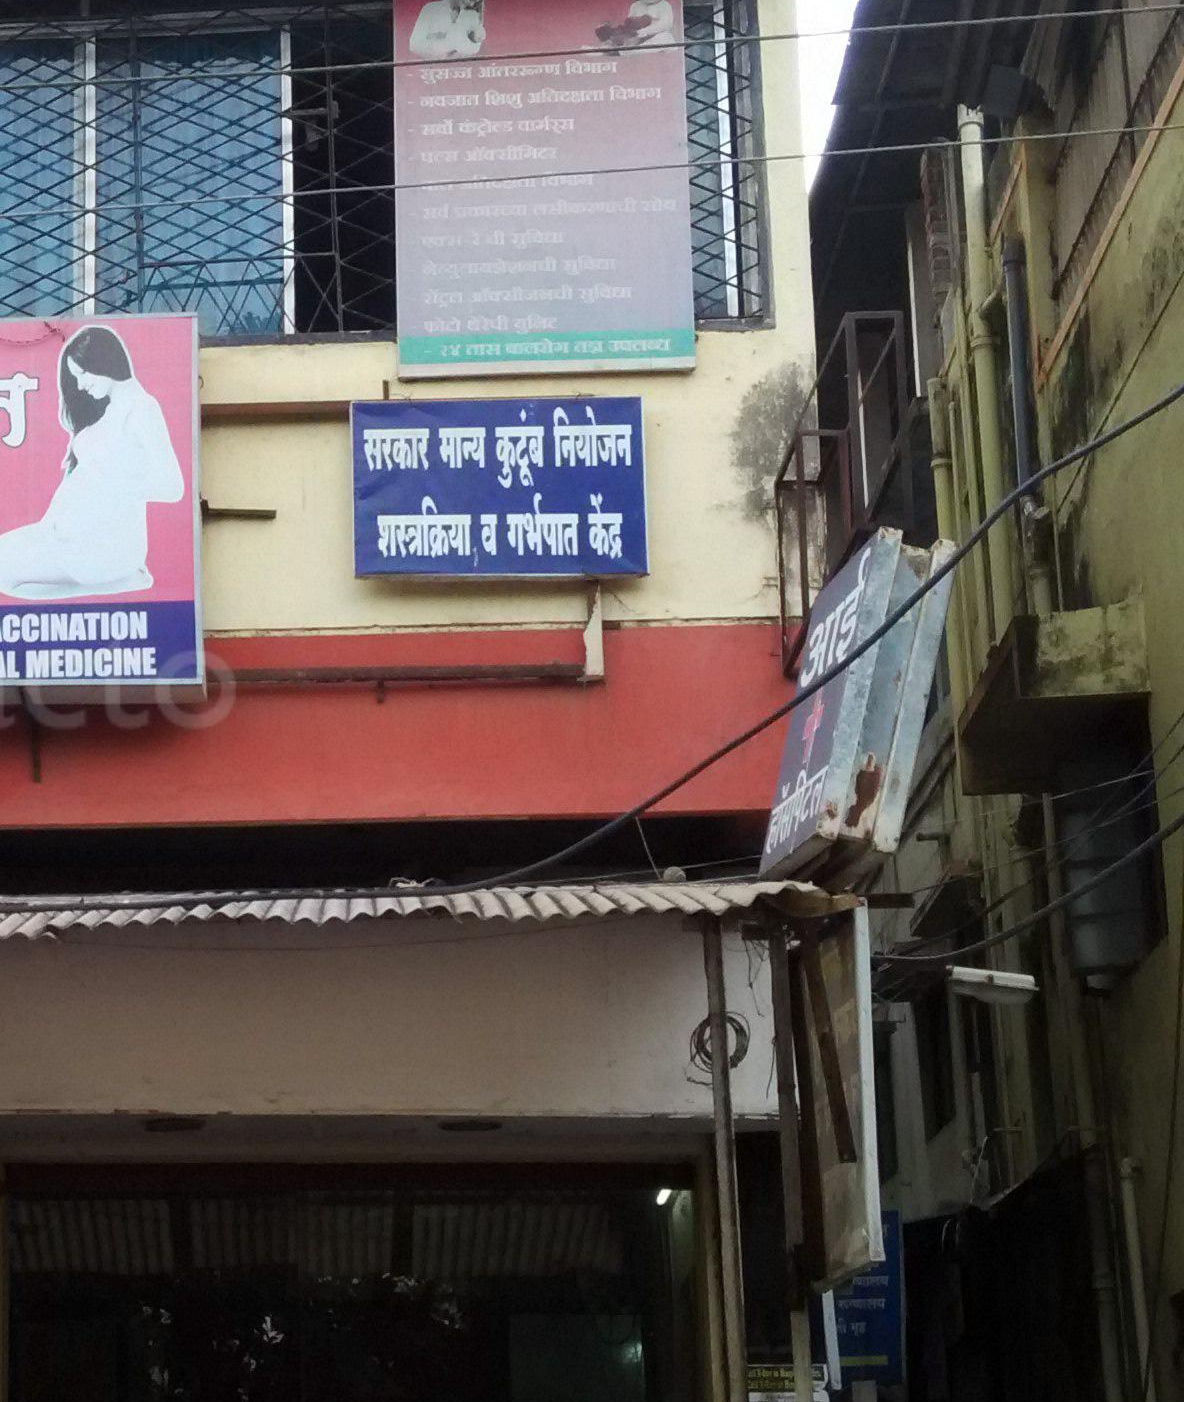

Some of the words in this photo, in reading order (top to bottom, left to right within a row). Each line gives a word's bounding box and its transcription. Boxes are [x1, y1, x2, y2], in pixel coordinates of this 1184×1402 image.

[565, 58, 617, 76] विभाग
[419, 93, 479, 108] नवजात
[485, 88, 523, 110] शिशु
[609, 84, 662, 102] विभाग
[364, 427, 430, 472] सरकार
[439, 426, 486, 470] मान्य
[553, 405, 632, 468] नियोजन
[480, 512, 498, 556] व
[507, 492, 579, 556] गर्भपात
[25, 647, 158, 679] MEDICINE
